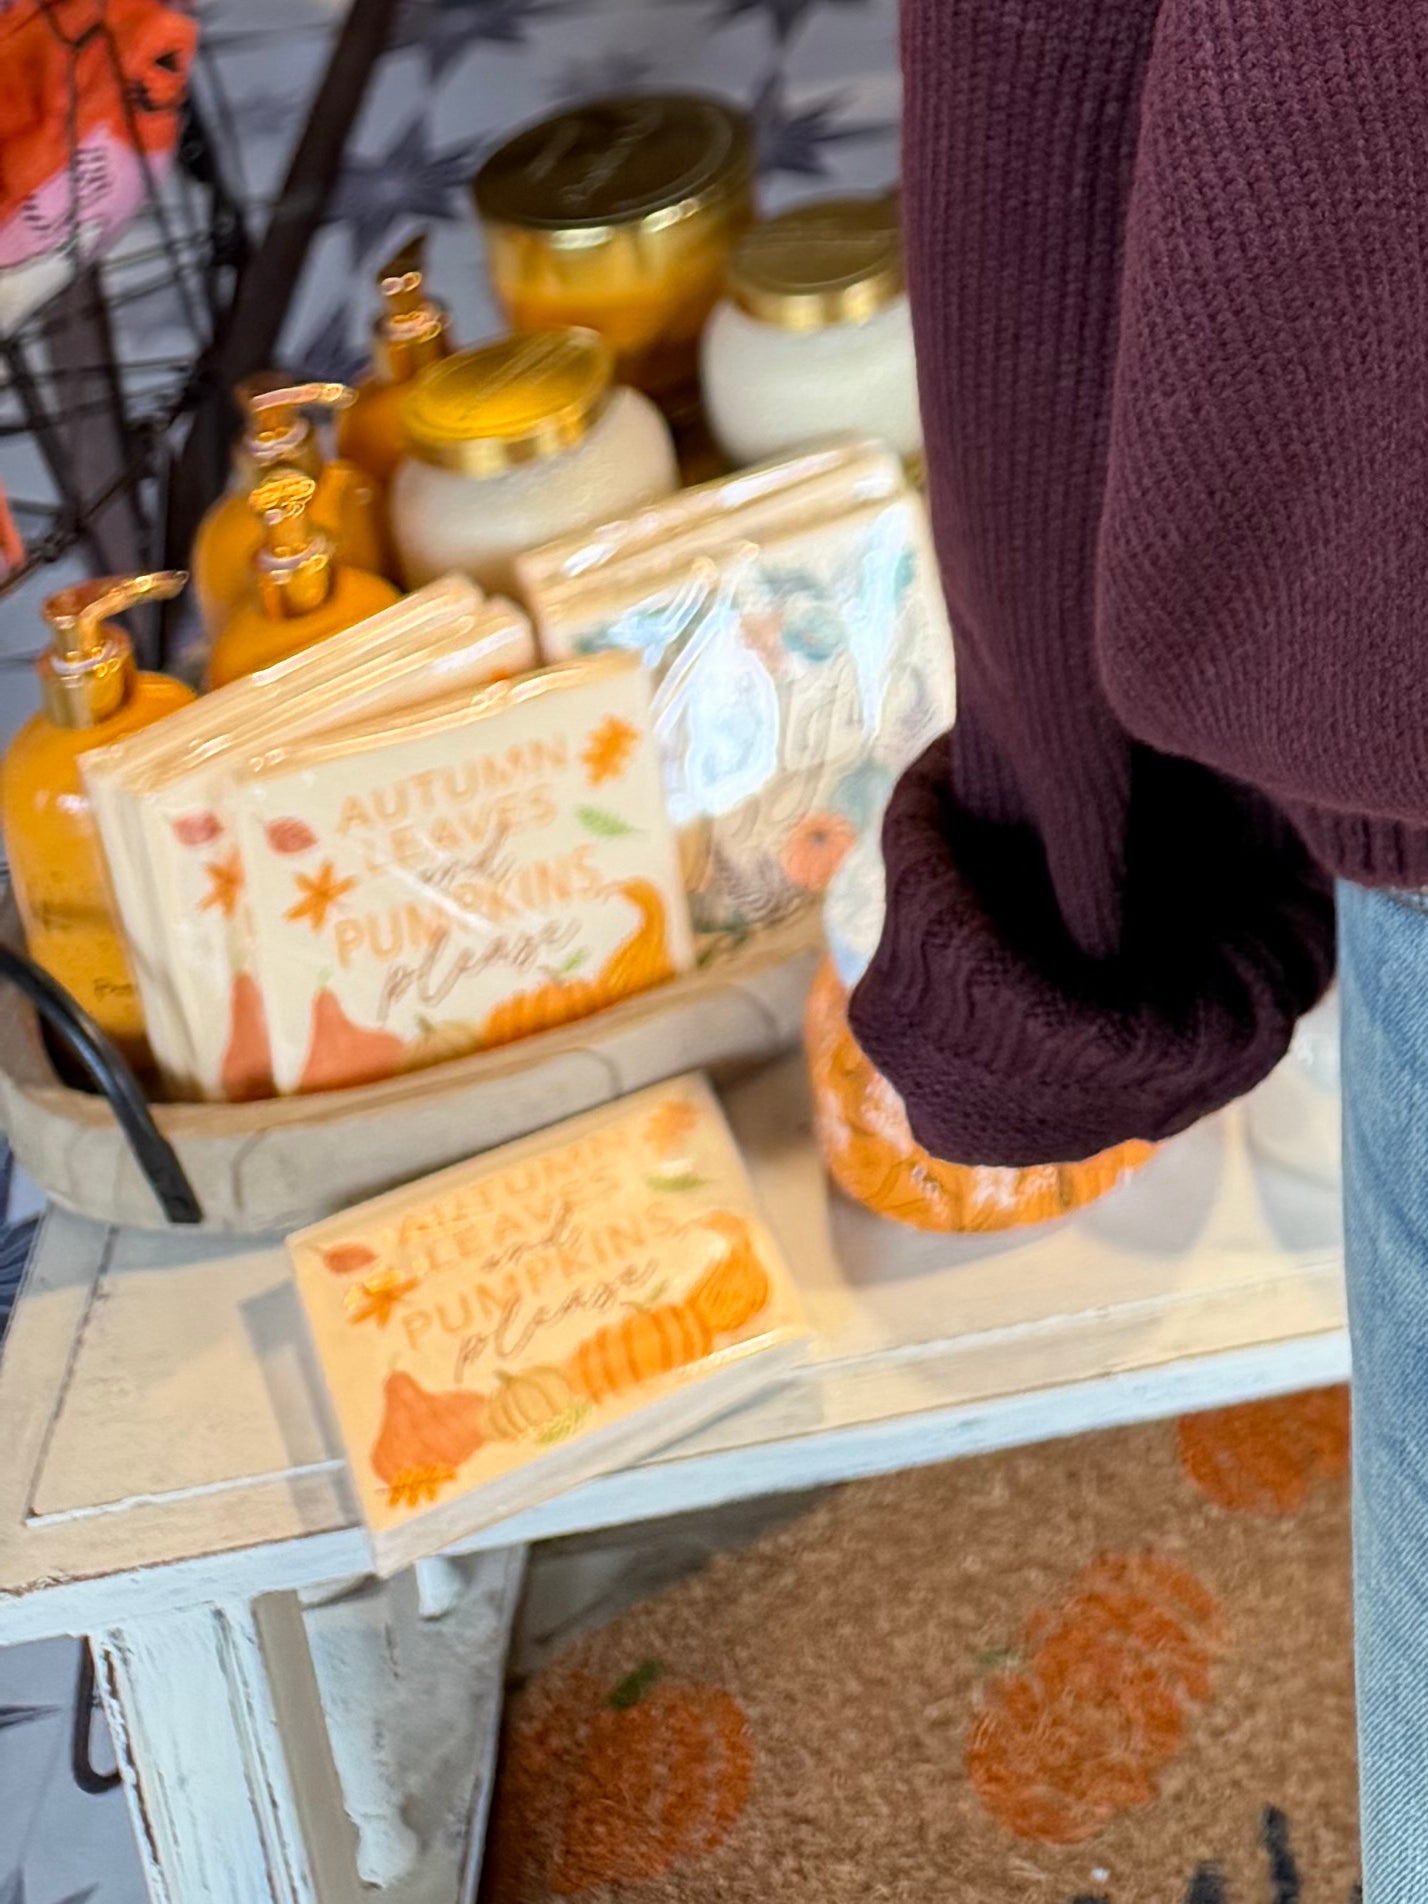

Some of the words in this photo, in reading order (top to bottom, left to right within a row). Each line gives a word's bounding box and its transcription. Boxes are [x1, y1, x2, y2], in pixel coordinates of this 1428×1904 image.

[338, 733, 569, 835] AUTUMN
[361, 784, 559, 875] LEAVES
[402, 1200, 676, 1350] PUMPKINS
